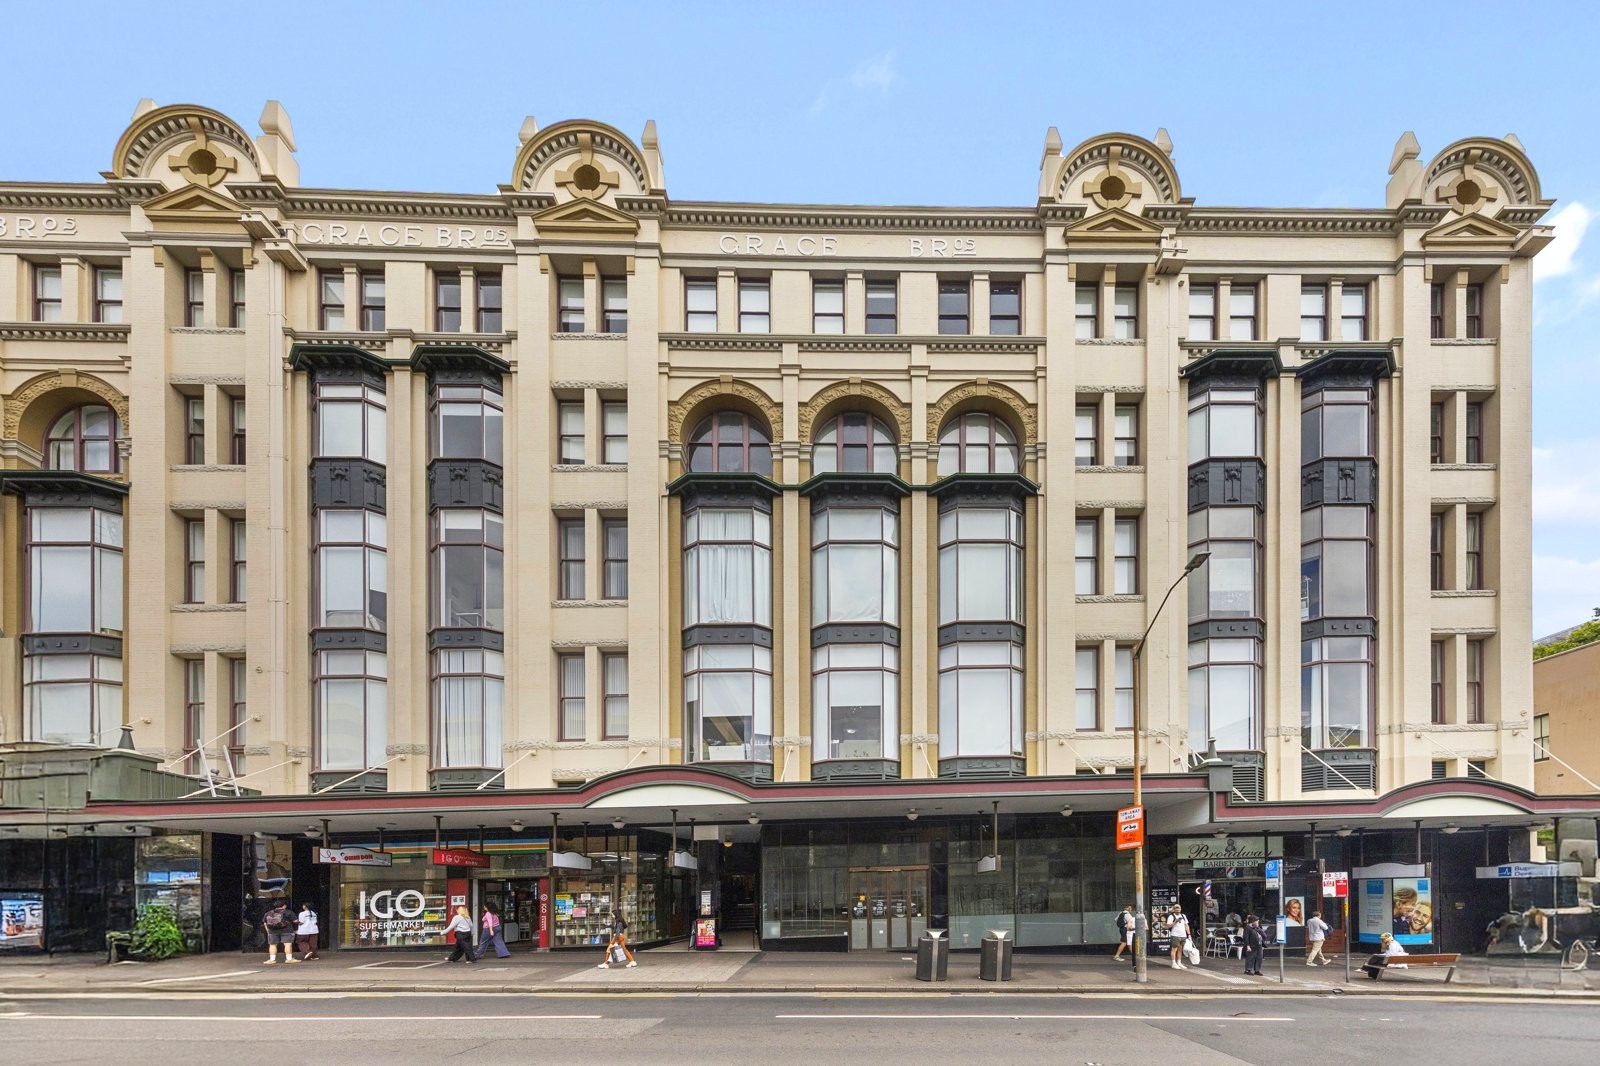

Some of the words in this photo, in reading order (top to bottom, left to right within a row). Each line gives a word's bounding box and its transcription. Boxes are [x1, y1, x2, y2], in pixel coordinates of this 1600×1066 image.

[301, 222, 424, 246] GRACE
[719, 233, 838, 257] GRACE
[441, 854, 460, 864] IGO
[1203, 860, 1236, 868] BARBER
[360, 889, 426, 920] IGO
[359, 920, 426, 930] SUPERMARKET
